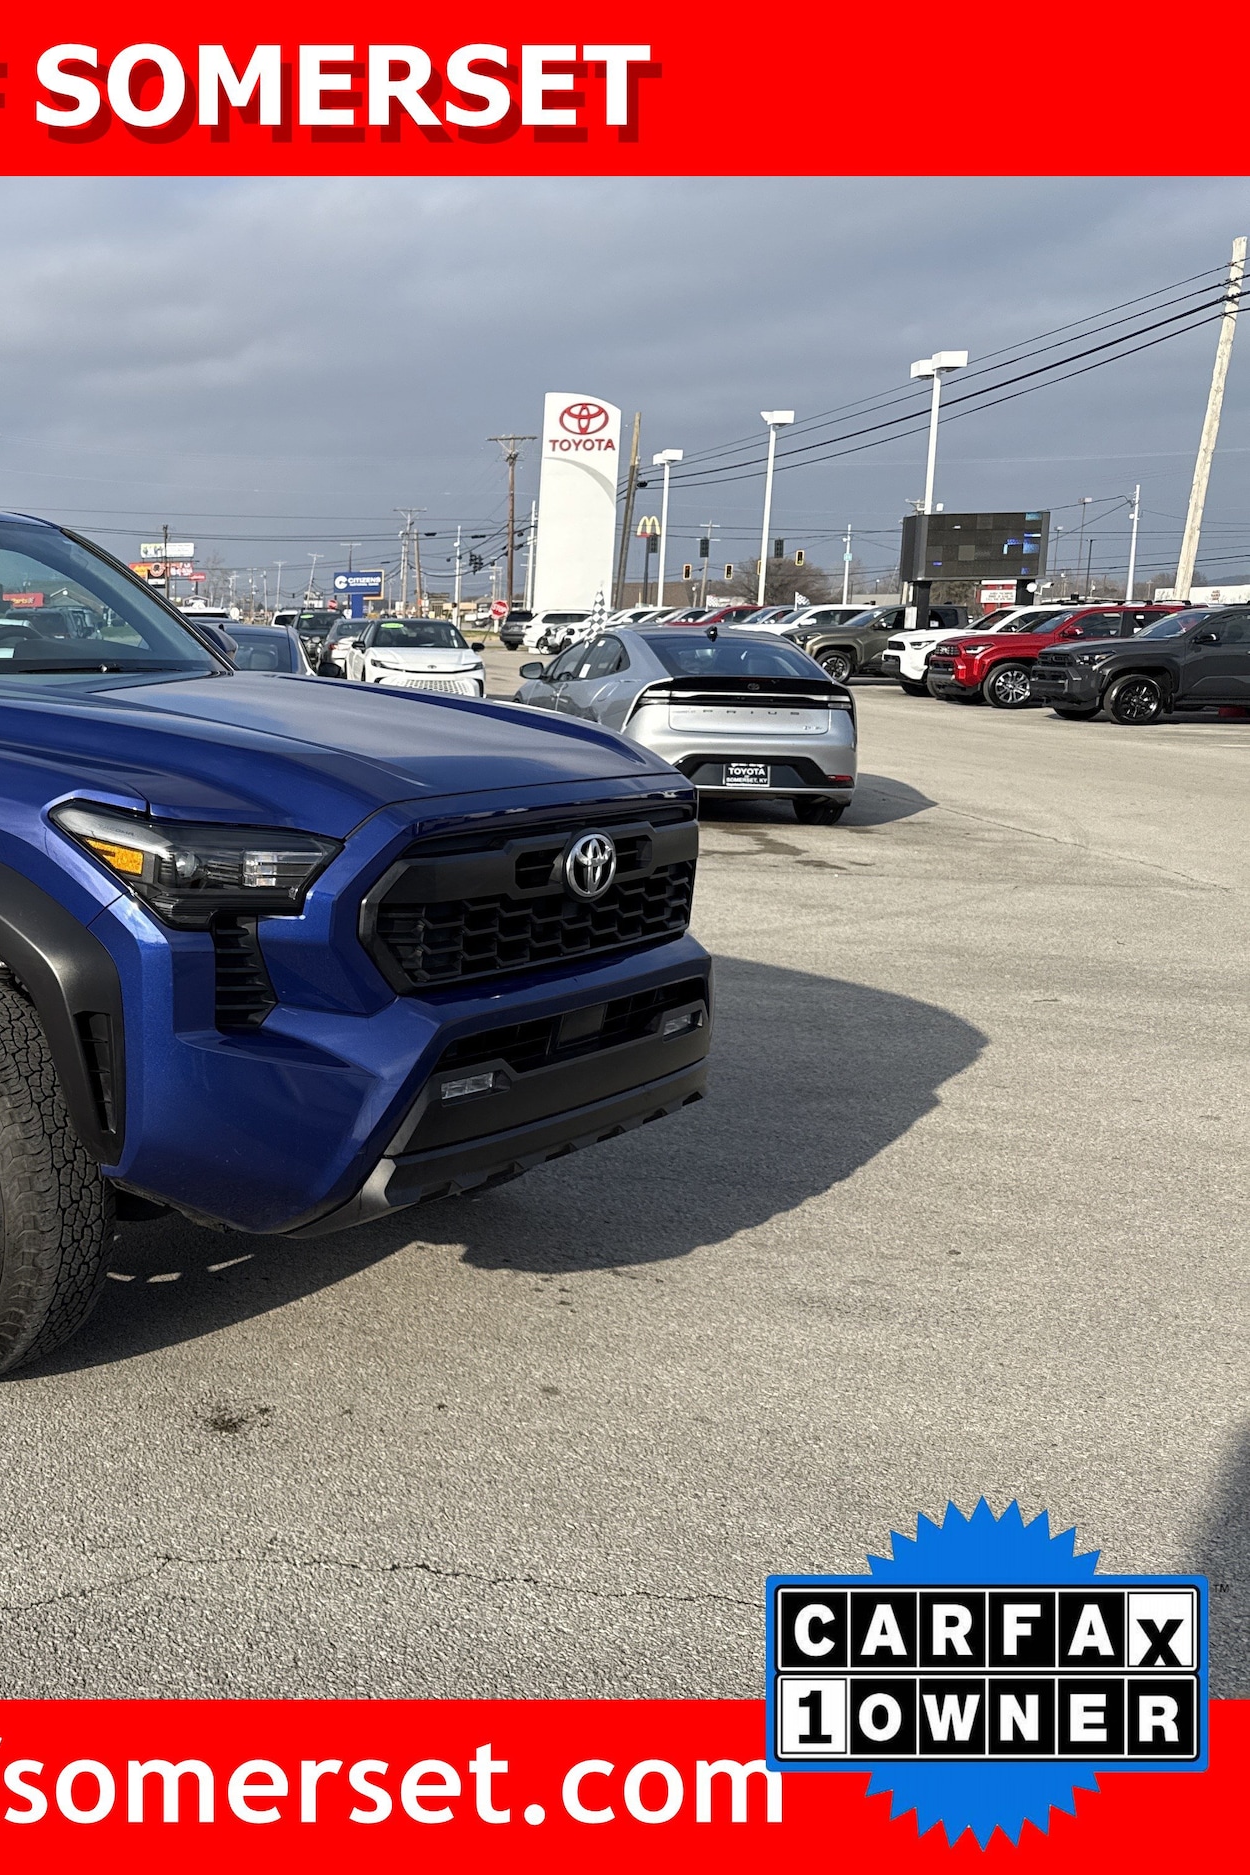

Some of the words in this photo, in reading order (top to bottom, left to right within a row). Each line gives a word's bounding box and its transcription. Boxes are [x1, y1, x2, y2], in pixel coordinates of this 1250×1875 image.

[549, 439, 616, 452] TOYOTA
[348, 576, 381, 584] CITIZENS
[491, 603, 508, 613] STOP
[728, 767, 766, 776] TOYOTA
